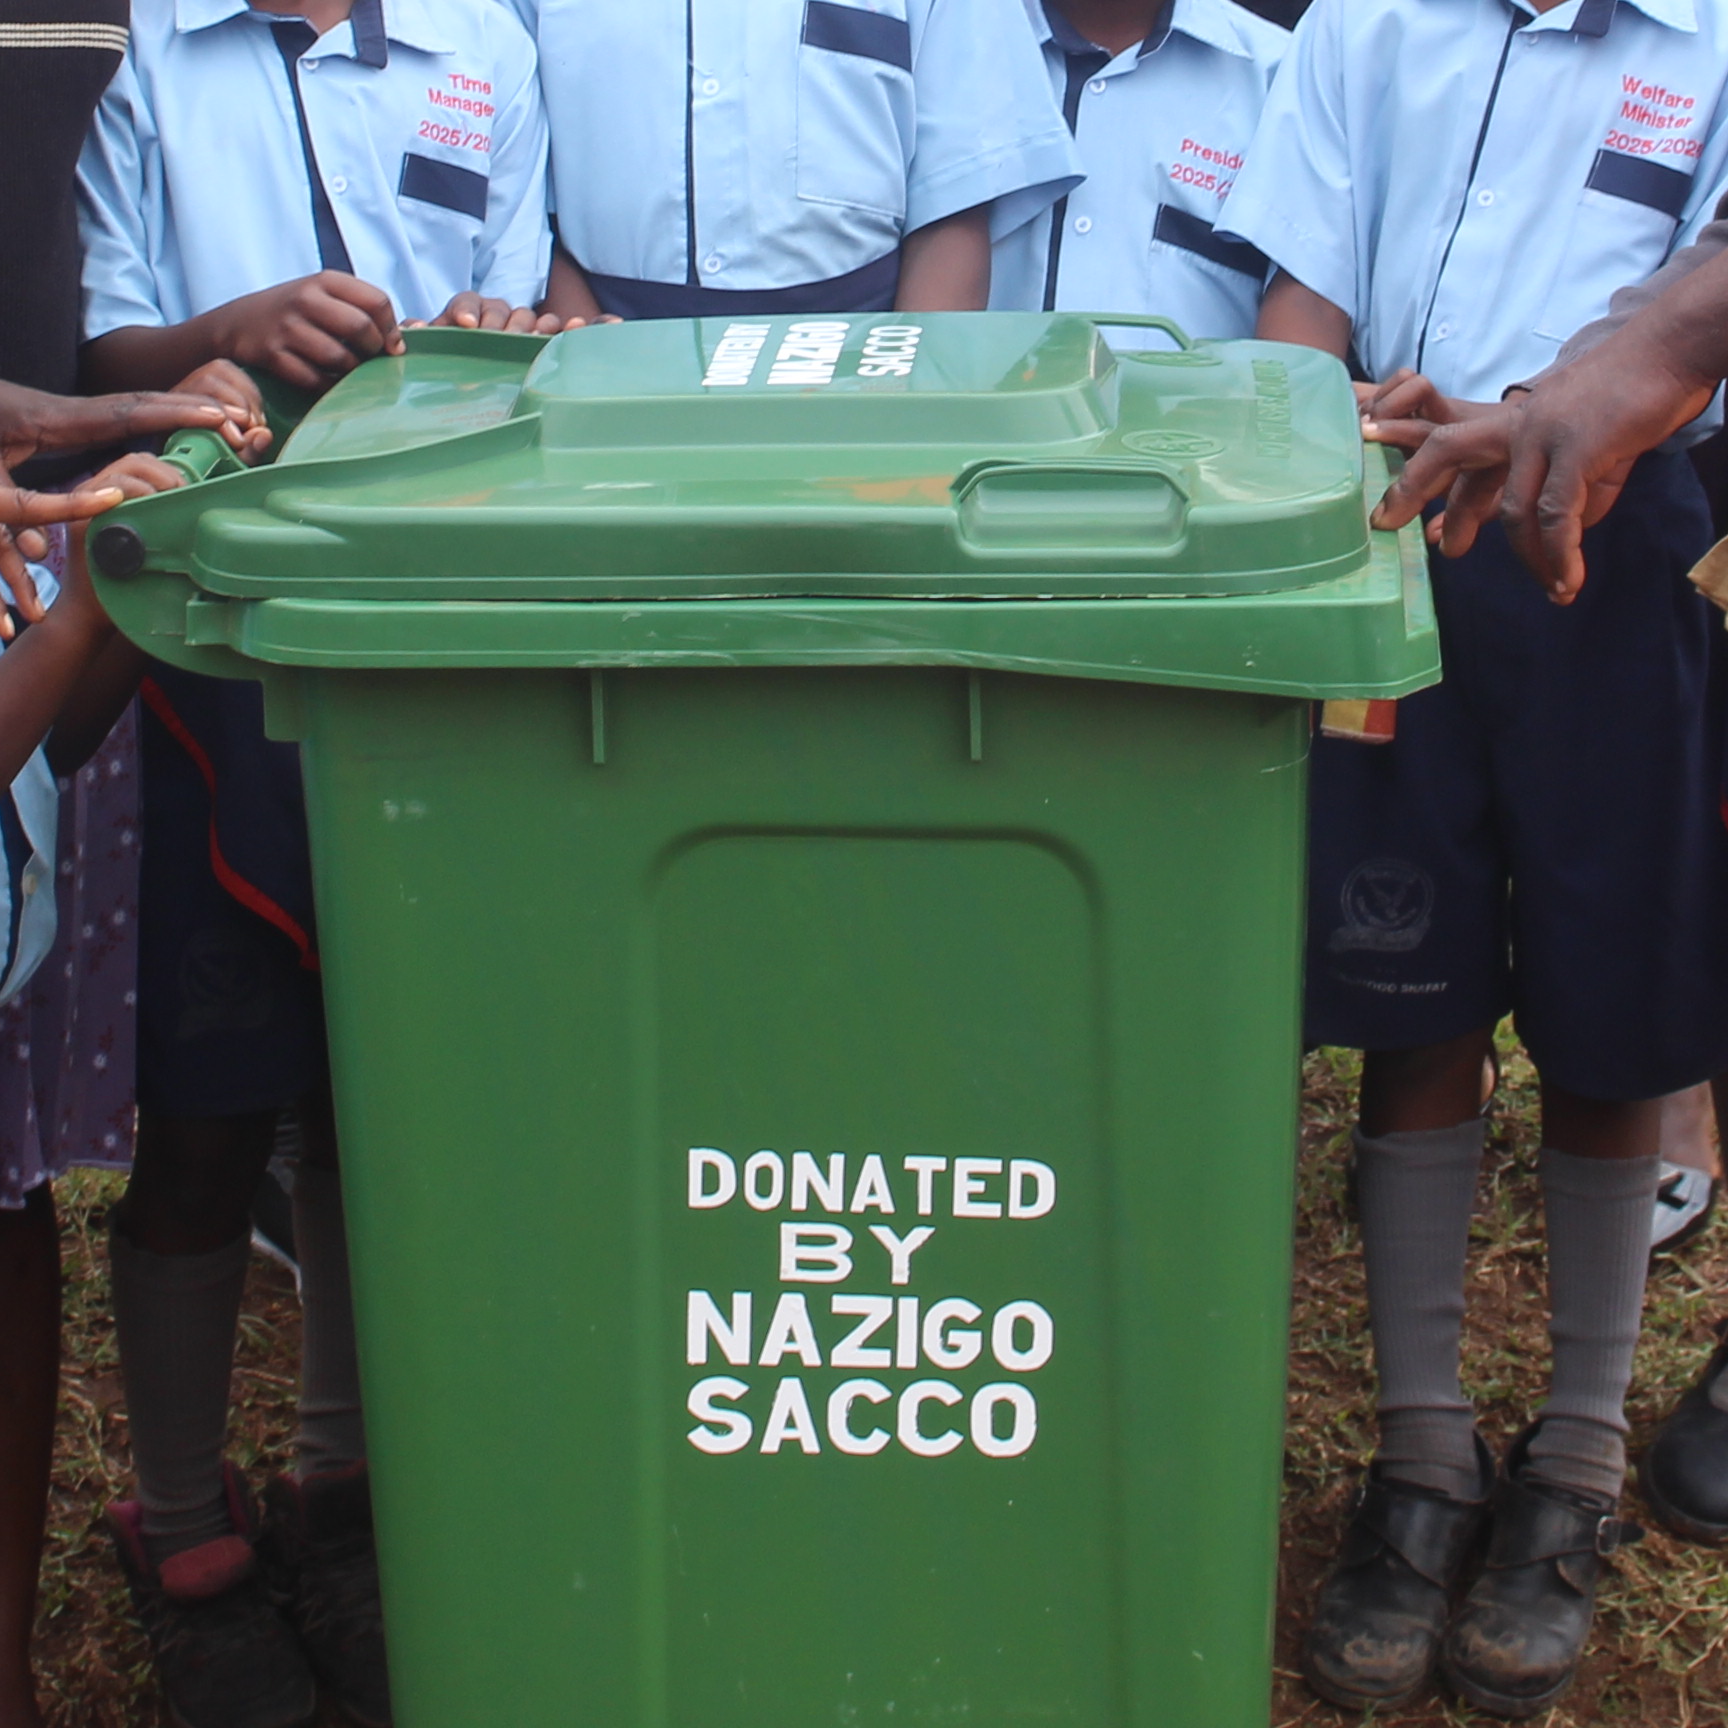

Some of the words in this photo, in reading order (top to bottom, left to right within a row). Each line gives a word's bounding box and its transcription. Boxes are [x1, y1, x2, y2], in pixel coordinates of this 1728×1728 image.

[448, 73, 492, 95] Time
[1620, 100, 1694, 129] Minister
[1622, 73, 1695, 109] Welfare
[766, 321, 851, 385] NAZIGO
[856, 325, 923, 377] SACCO
[687, 1148, 1056, 1219] DONATED
[779, 1222, 936, 1285] BY
[686, 1290, 1055, 1371] NAZIGO
[686, 1376, 1038, 1458] SACCO
